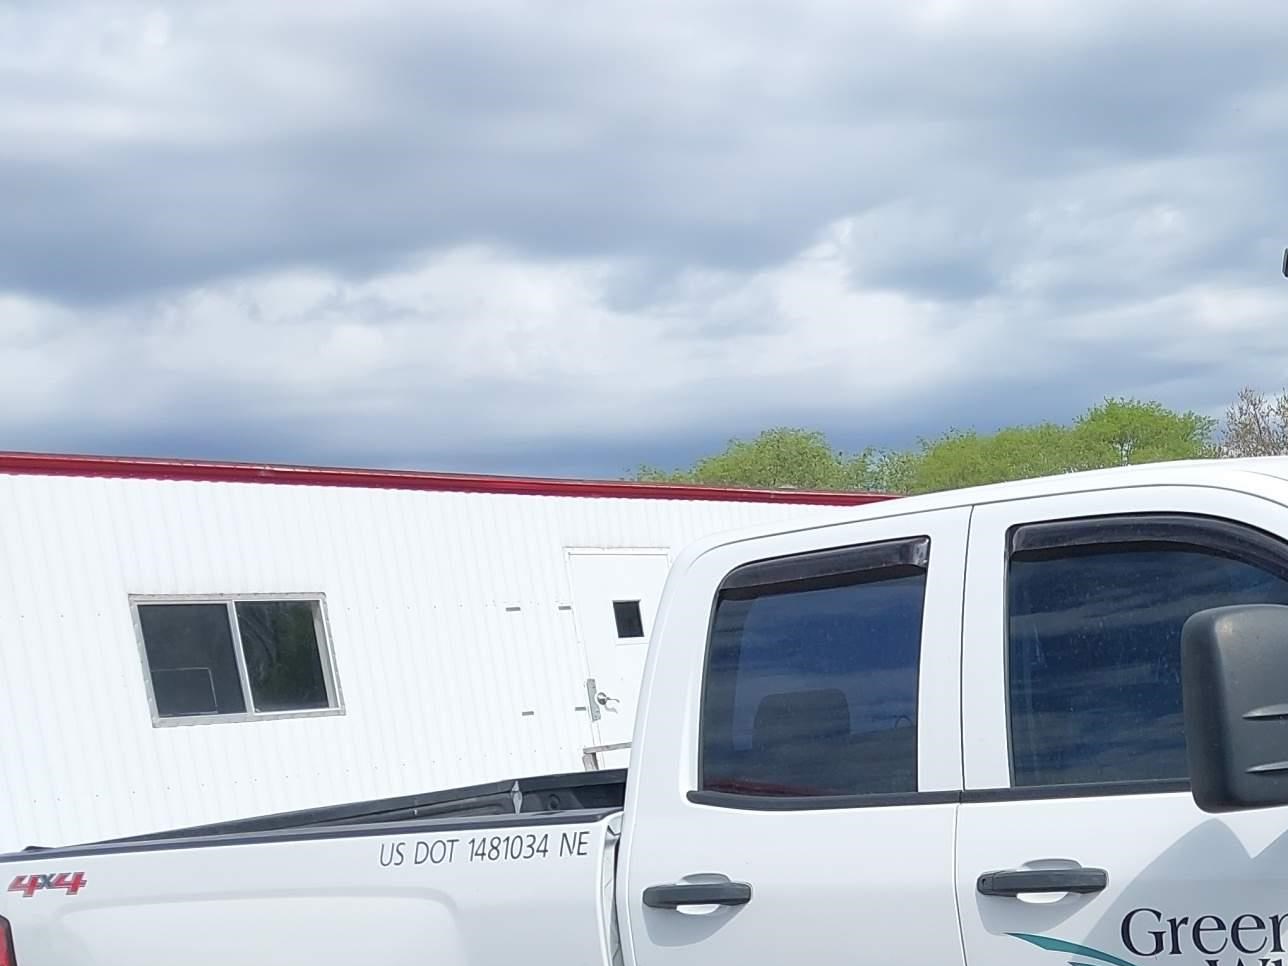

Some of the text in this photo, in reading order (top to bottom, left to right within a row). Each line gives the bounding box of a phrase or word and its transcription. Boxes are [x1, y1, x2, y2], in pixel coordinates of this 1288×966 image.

[379, 831, 590, 866] US DOT 1481034 NE
